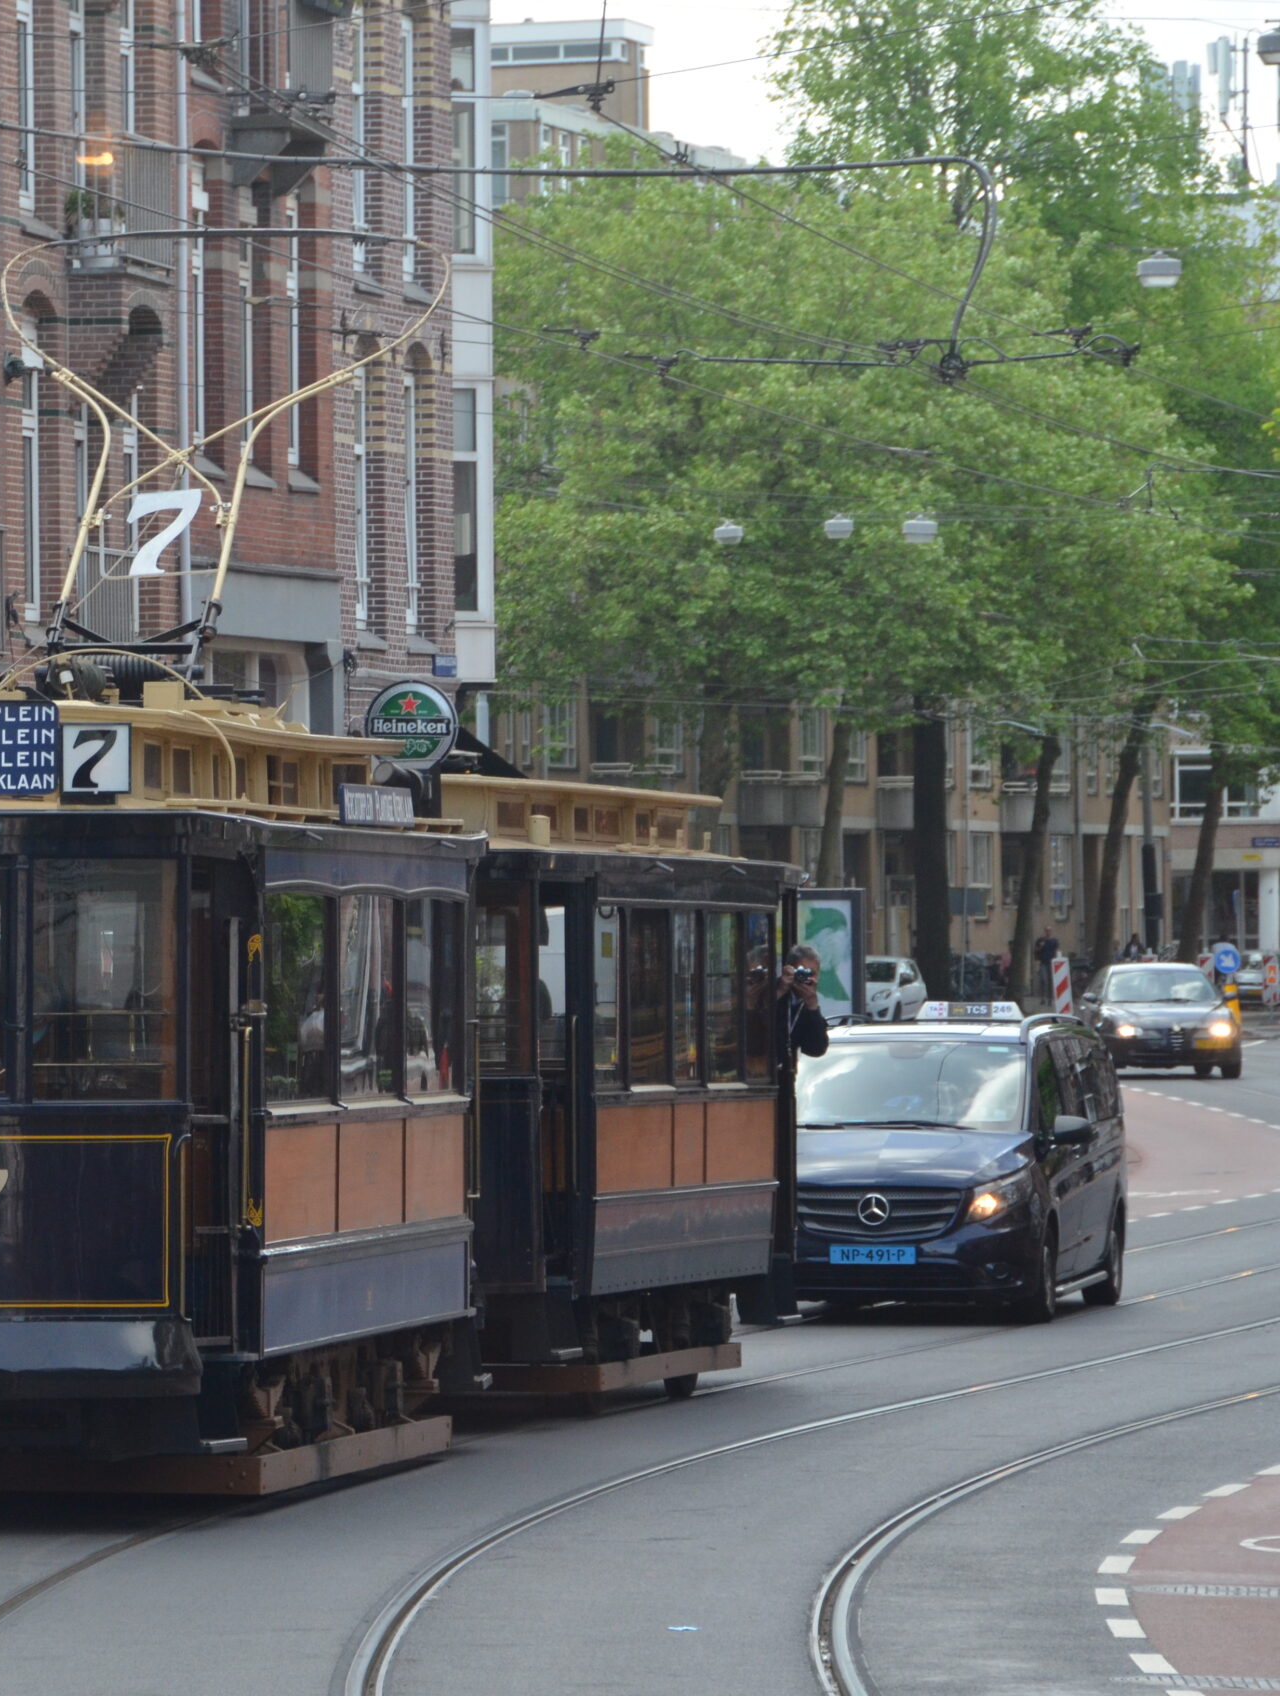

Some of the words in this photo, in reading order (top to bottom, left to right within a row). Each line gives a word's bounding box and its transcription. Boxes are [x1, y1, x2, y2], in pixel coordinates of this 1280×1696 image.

[126, 488, 202, 577] 7
[372, 718, 446, 734] Heineken
[72, 729, 118, 789] 7
[966, 1006, 988, 1014] TCS
[841, 1249, 906, 1262] NP-491-P
